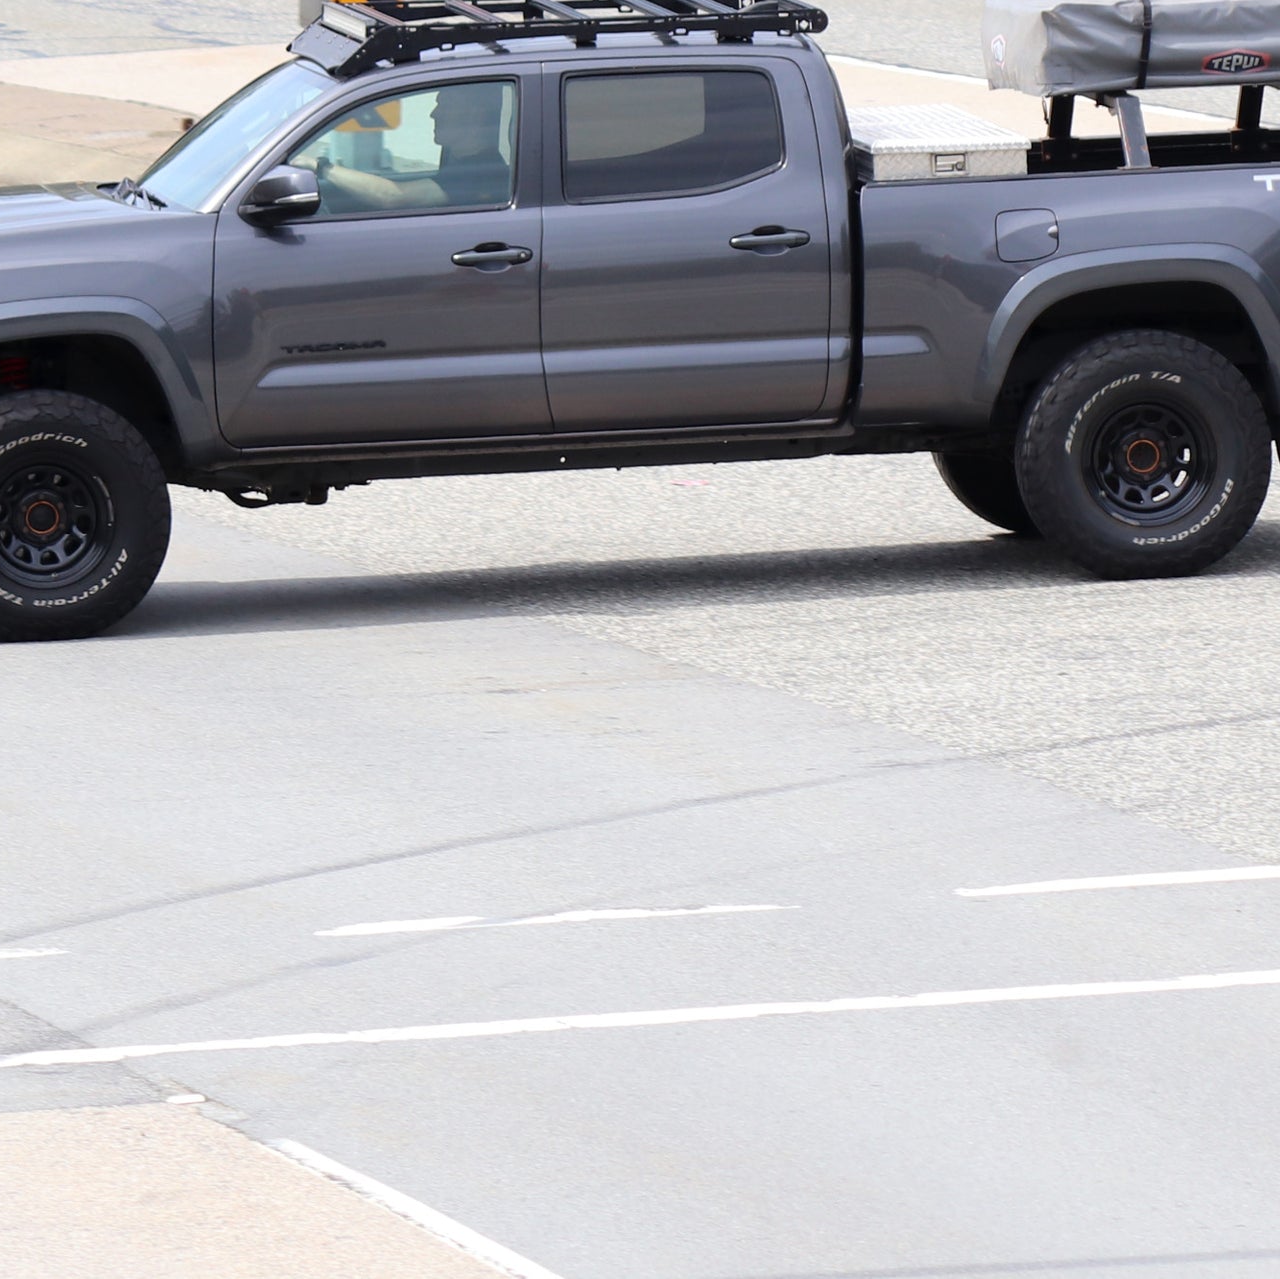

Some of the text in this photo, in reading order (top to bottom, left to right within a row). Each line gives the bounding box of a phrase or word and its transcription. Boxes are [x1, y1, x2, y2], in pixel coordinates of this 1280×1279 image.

[1212, 54, 1260, 72] TEPUI
[1064, 373, 1141, 455] All-Terrain
[1132, 478, 1234, 547] BFGoodrich
[32, 547, 129, 608] All-Terrain
